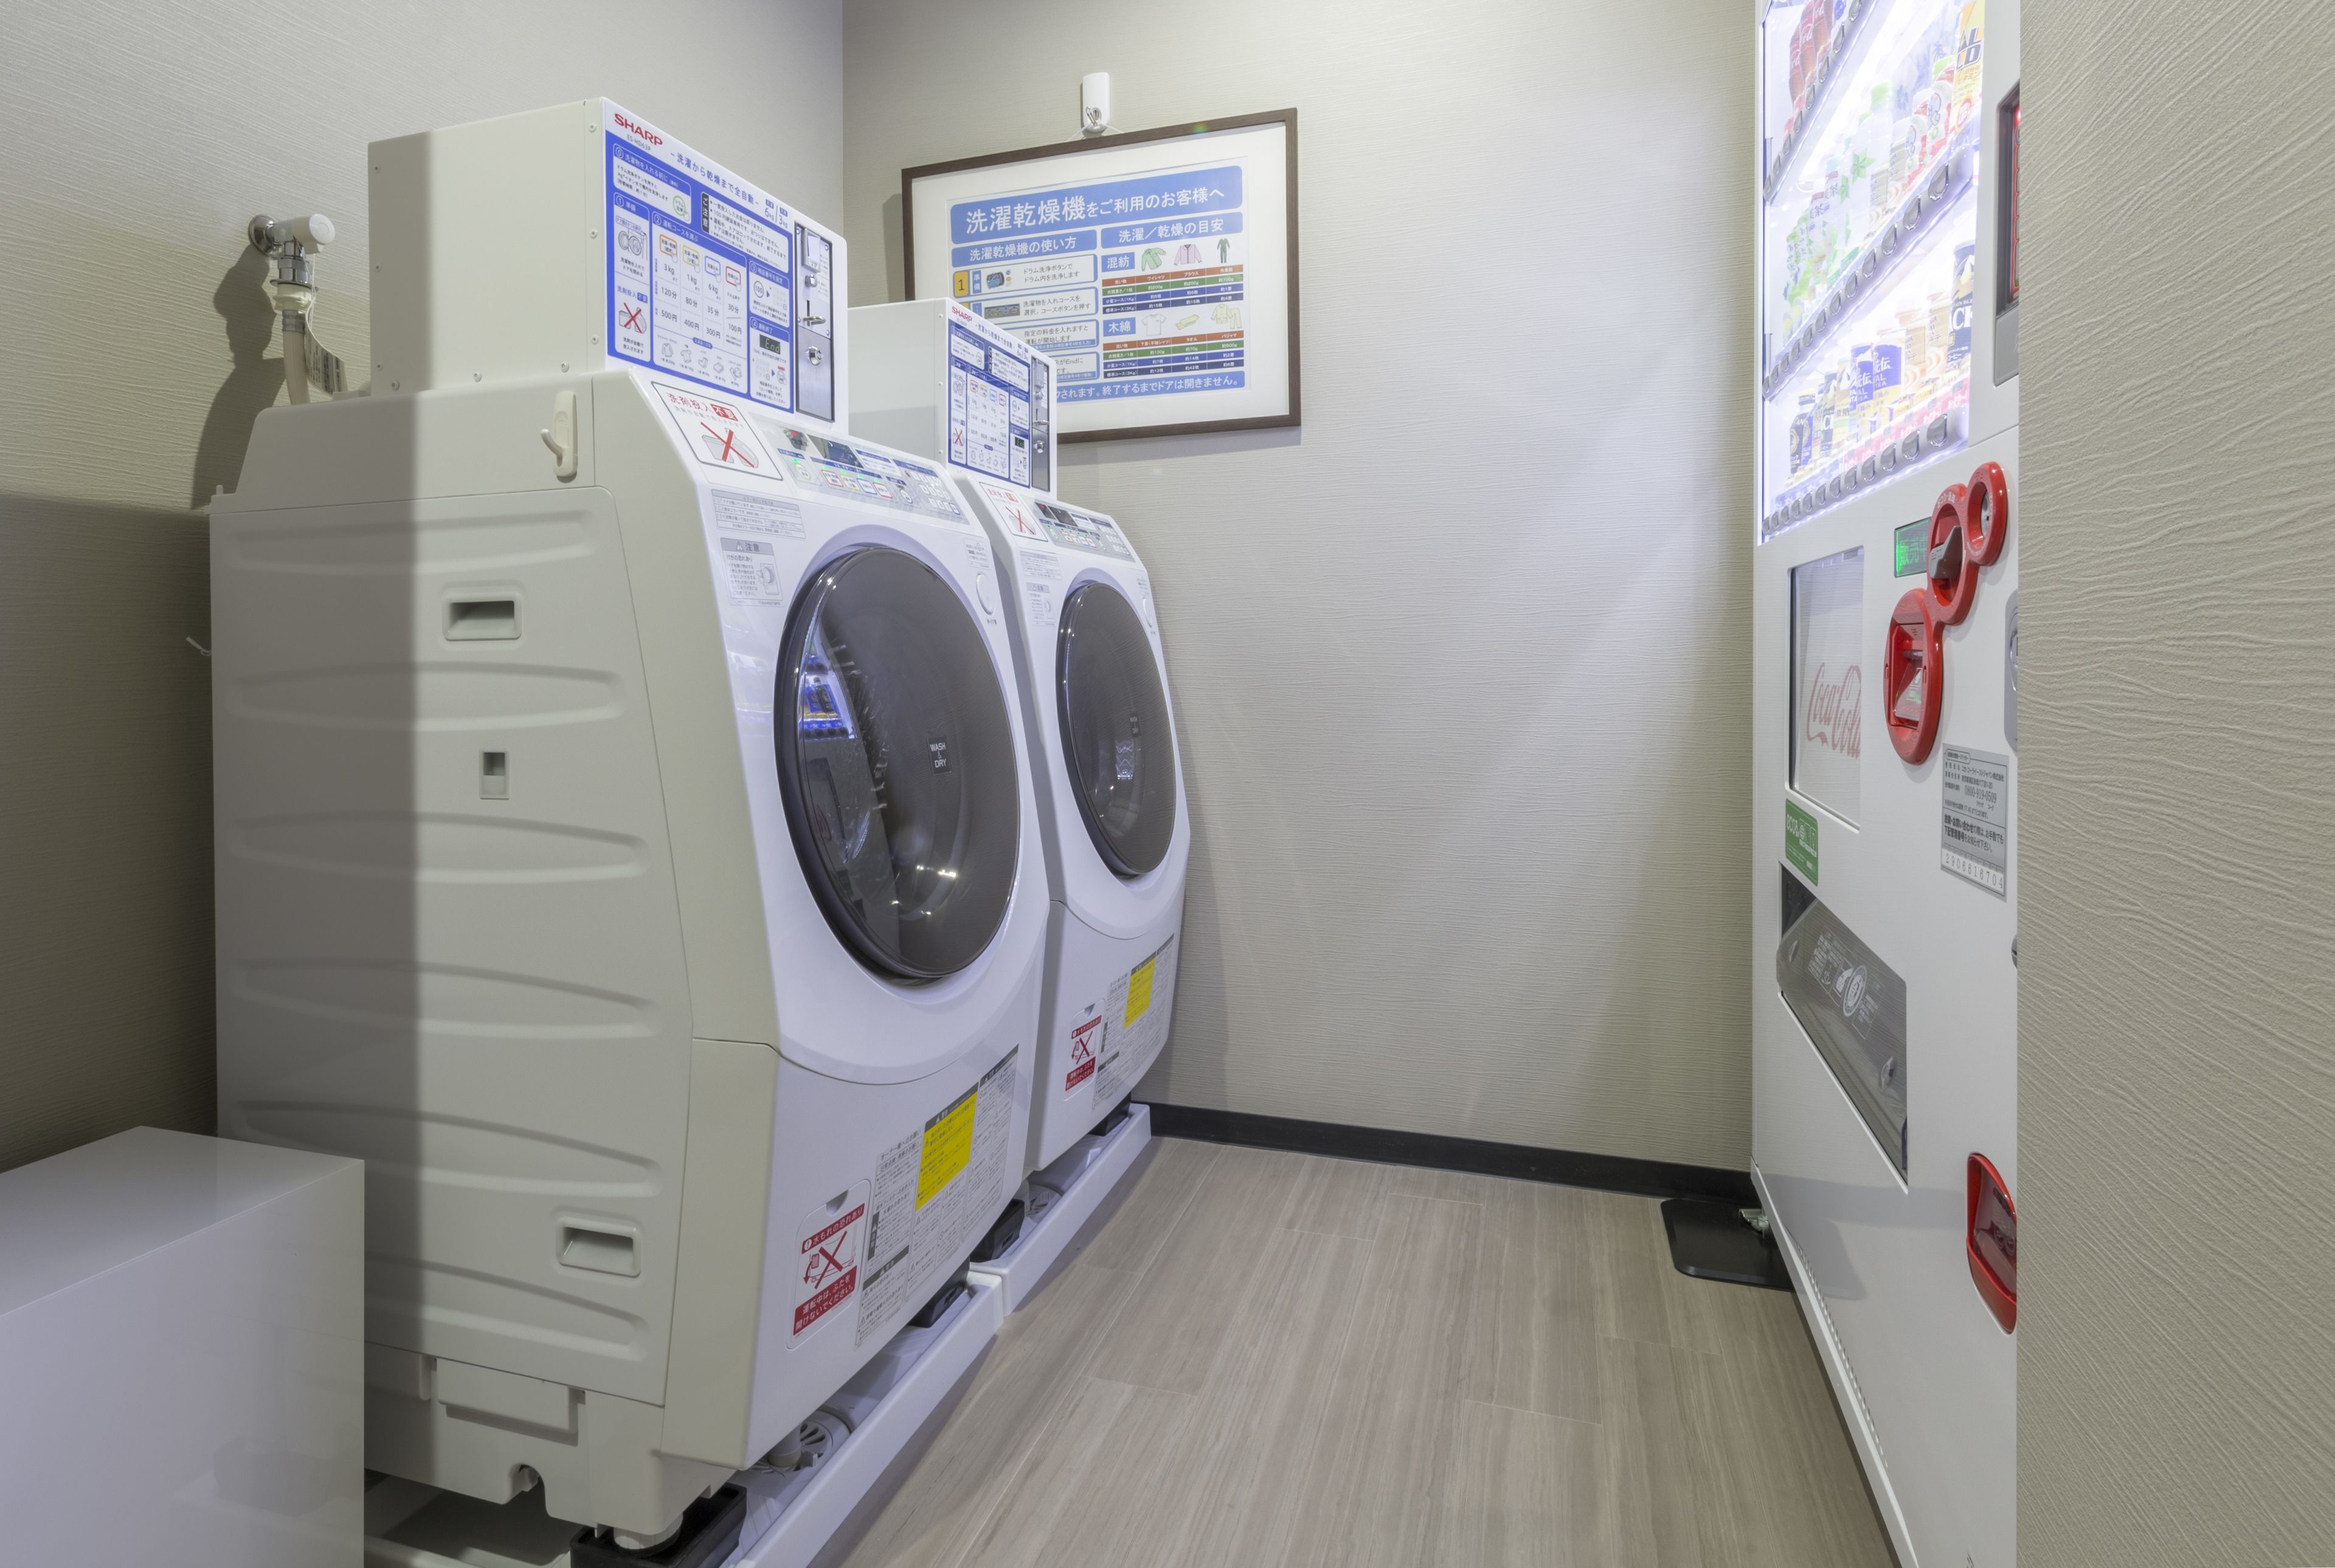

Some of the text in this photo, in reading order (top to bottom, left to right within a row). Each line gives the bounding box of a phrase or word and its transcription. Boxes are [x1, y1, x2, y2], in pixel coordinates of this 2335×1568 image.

[614, 113, 663, 146] SHARP
[966, 186, 1225, 235] 洗濯乾燥機をご利用のお客様へ
[969, 235, 1077, 261] 洗濯乾燥機の使い方
[1023, 263, 1073, 274] ドラム洗浄ボタンで
[1107, 257, 1130, 269] 混紡
[1024, 271, 1079, 283] ドラム内を洗浄します
[958, 279, 965, 291] 1
[661, 286, 677, 300] 120分
[685, 297, 698, 308] 80分
[1023, 295, 1081, 308] 洗濯物を入れコースを
[707, 306, 719, 317] 35分
[728, 303, 739, 314] 30分
[952, 306, 973, 322] SHARP
[661, 309, 677, 322] 500円
[684, 319, 700, 331] 400円
[728, 323, 742, 334] 100円
[1024, 325, 1088, 337] 指定の料金を入れますと
[1108, 320, 1131, 334] 木綿
[706, 326, 721, 339] 300円
[765, 337, 780, 353] End
[745, 542, 760, 552] 注意
[929, 742, 946, 752] WASH
[934, 758, 947, 768] DRY
[812, 1206, 863, 1246] 水もれの恐れあり
[802, 1274, 851, 1316] 運転中は、ふたを
[795, 1285, 854, 1331] 開けないでください。
